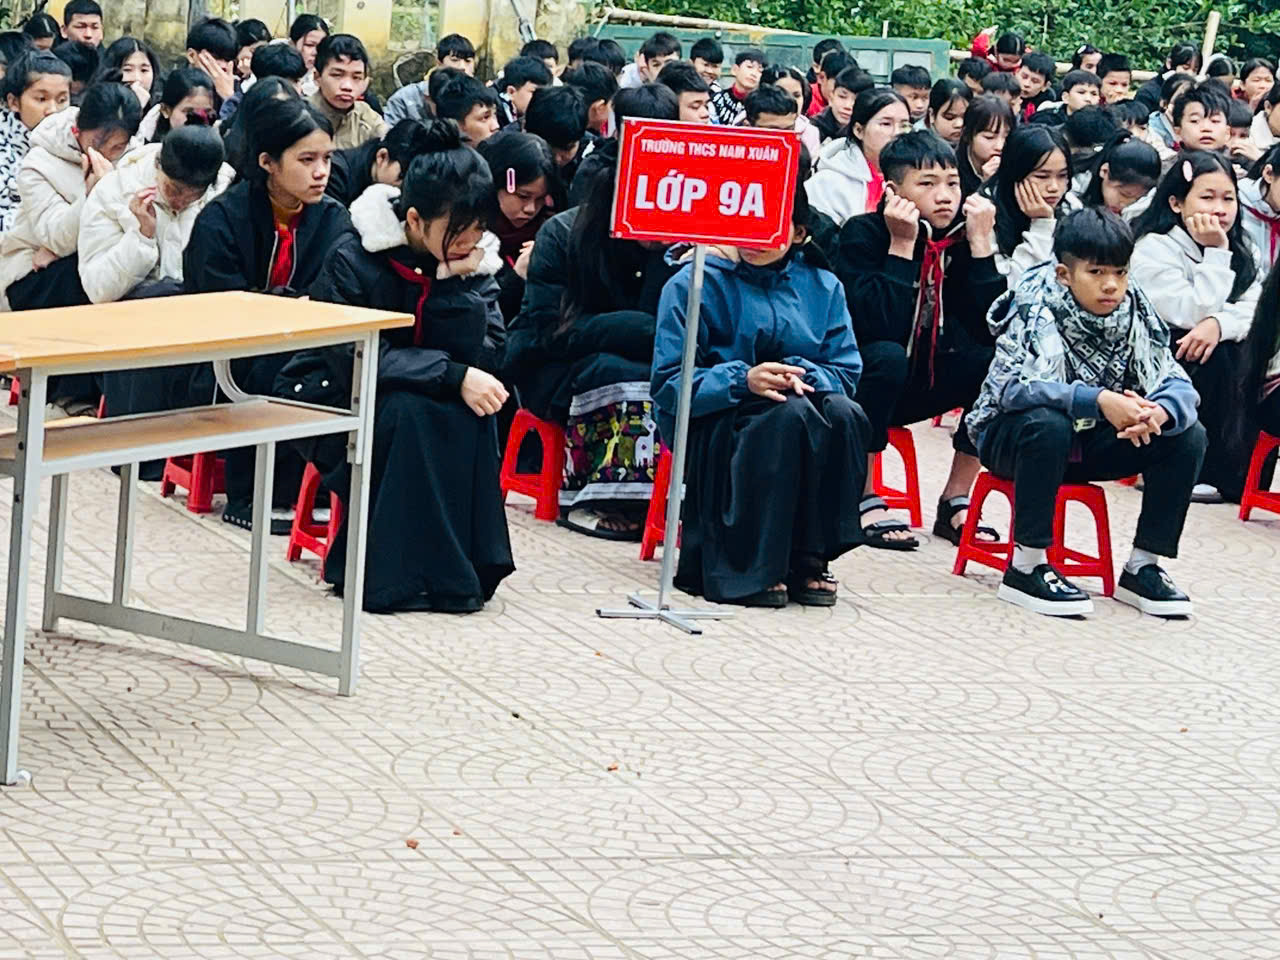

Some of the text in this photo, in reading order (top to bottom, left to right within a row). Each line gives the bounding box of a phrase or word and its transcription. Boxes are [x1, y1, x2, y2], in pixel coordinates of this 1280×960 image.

[640, 137, 779, 162] TRƯỜNG THCS NAM XUÂN
[635, 169, 765, 218] LỚP 9A
